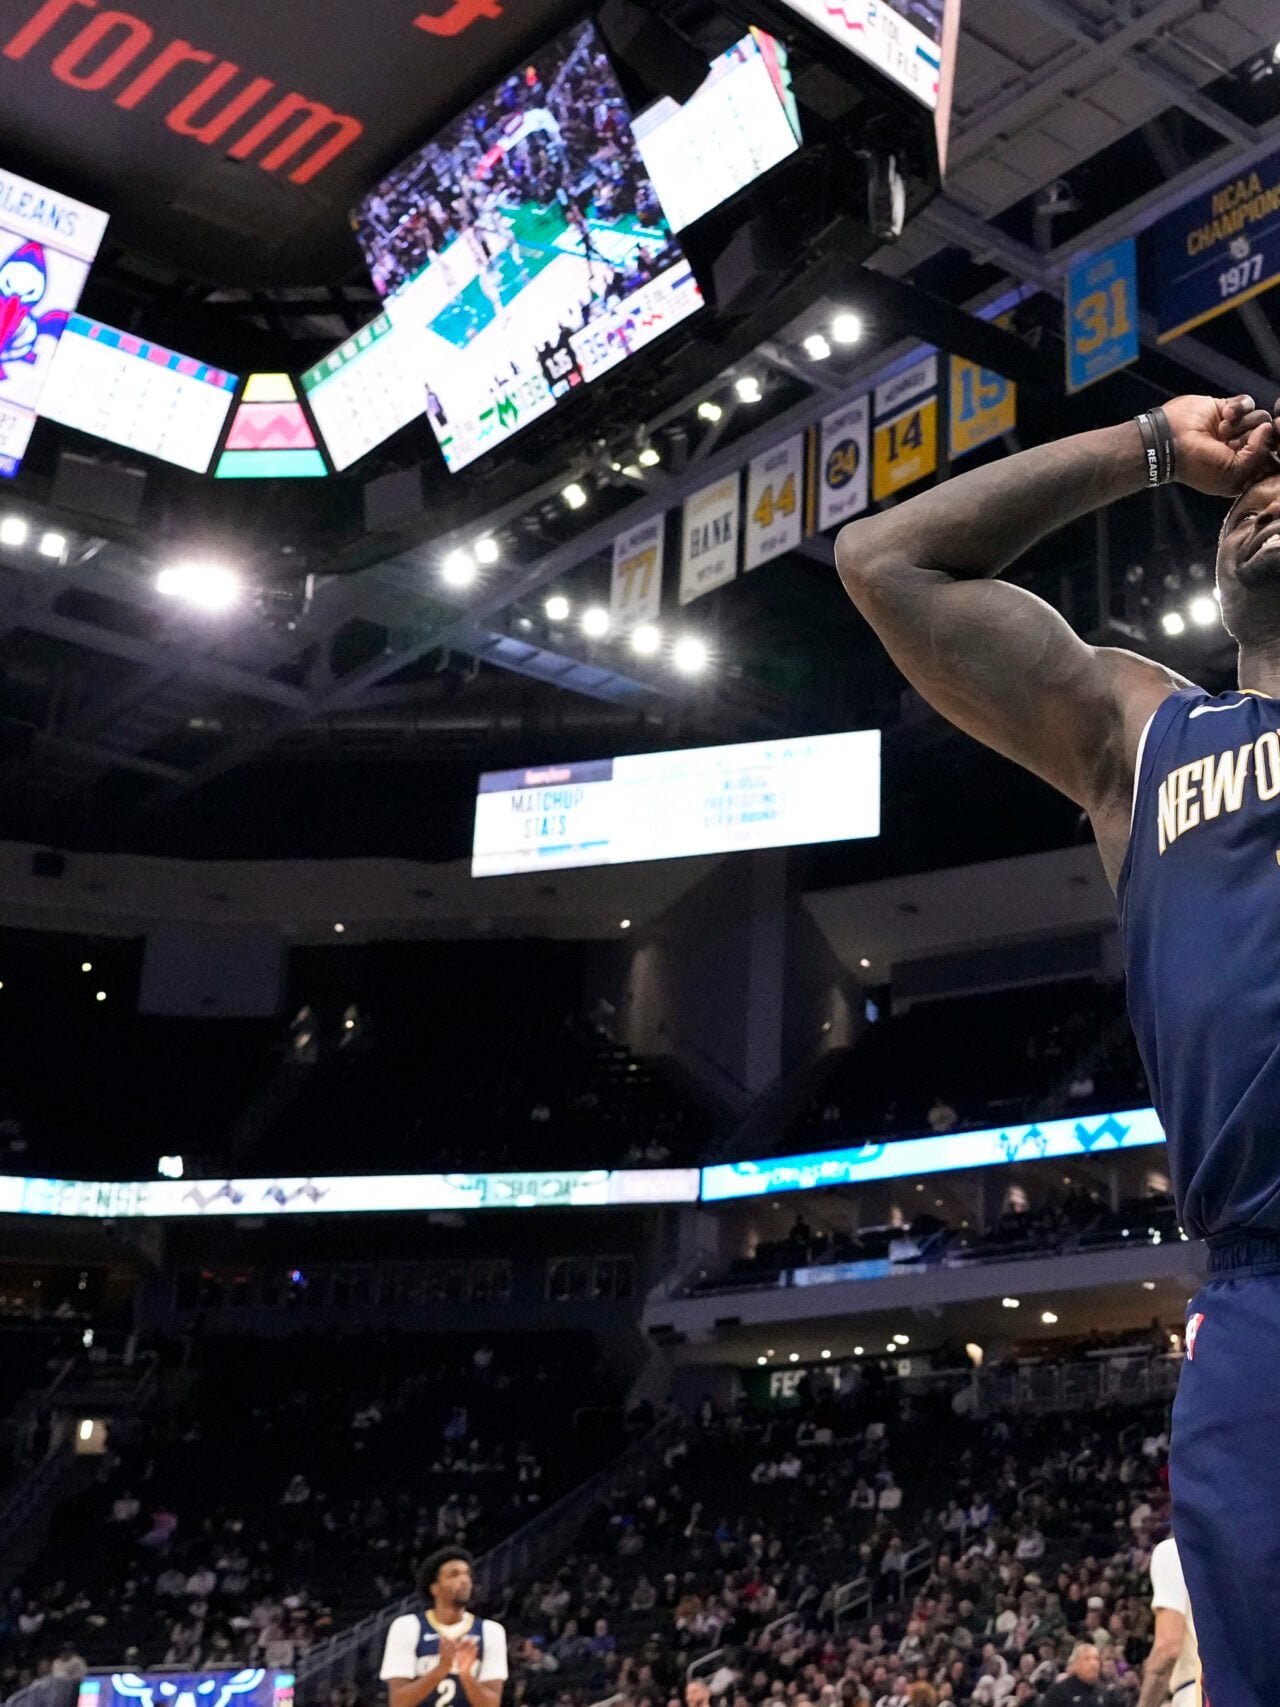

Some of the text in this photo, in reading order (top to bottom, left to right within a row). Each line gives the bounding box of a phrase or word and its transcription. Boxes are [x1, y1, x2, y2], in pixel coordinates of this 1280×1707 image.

[1212, 172, 1262, 216] NCAA
[1217, 254, 1264, 297] 1977
[1075, 278, 1131, 353] 31
[887, 409, 923, 463] 14
[1147, 448, 1159, 482] READY
[752, 472, 797, 528] 44
[690, 511, 734, 560] HANK
[1157, 743, 1254, 856] NEW
[434, 1678, 457, 1707] 2
